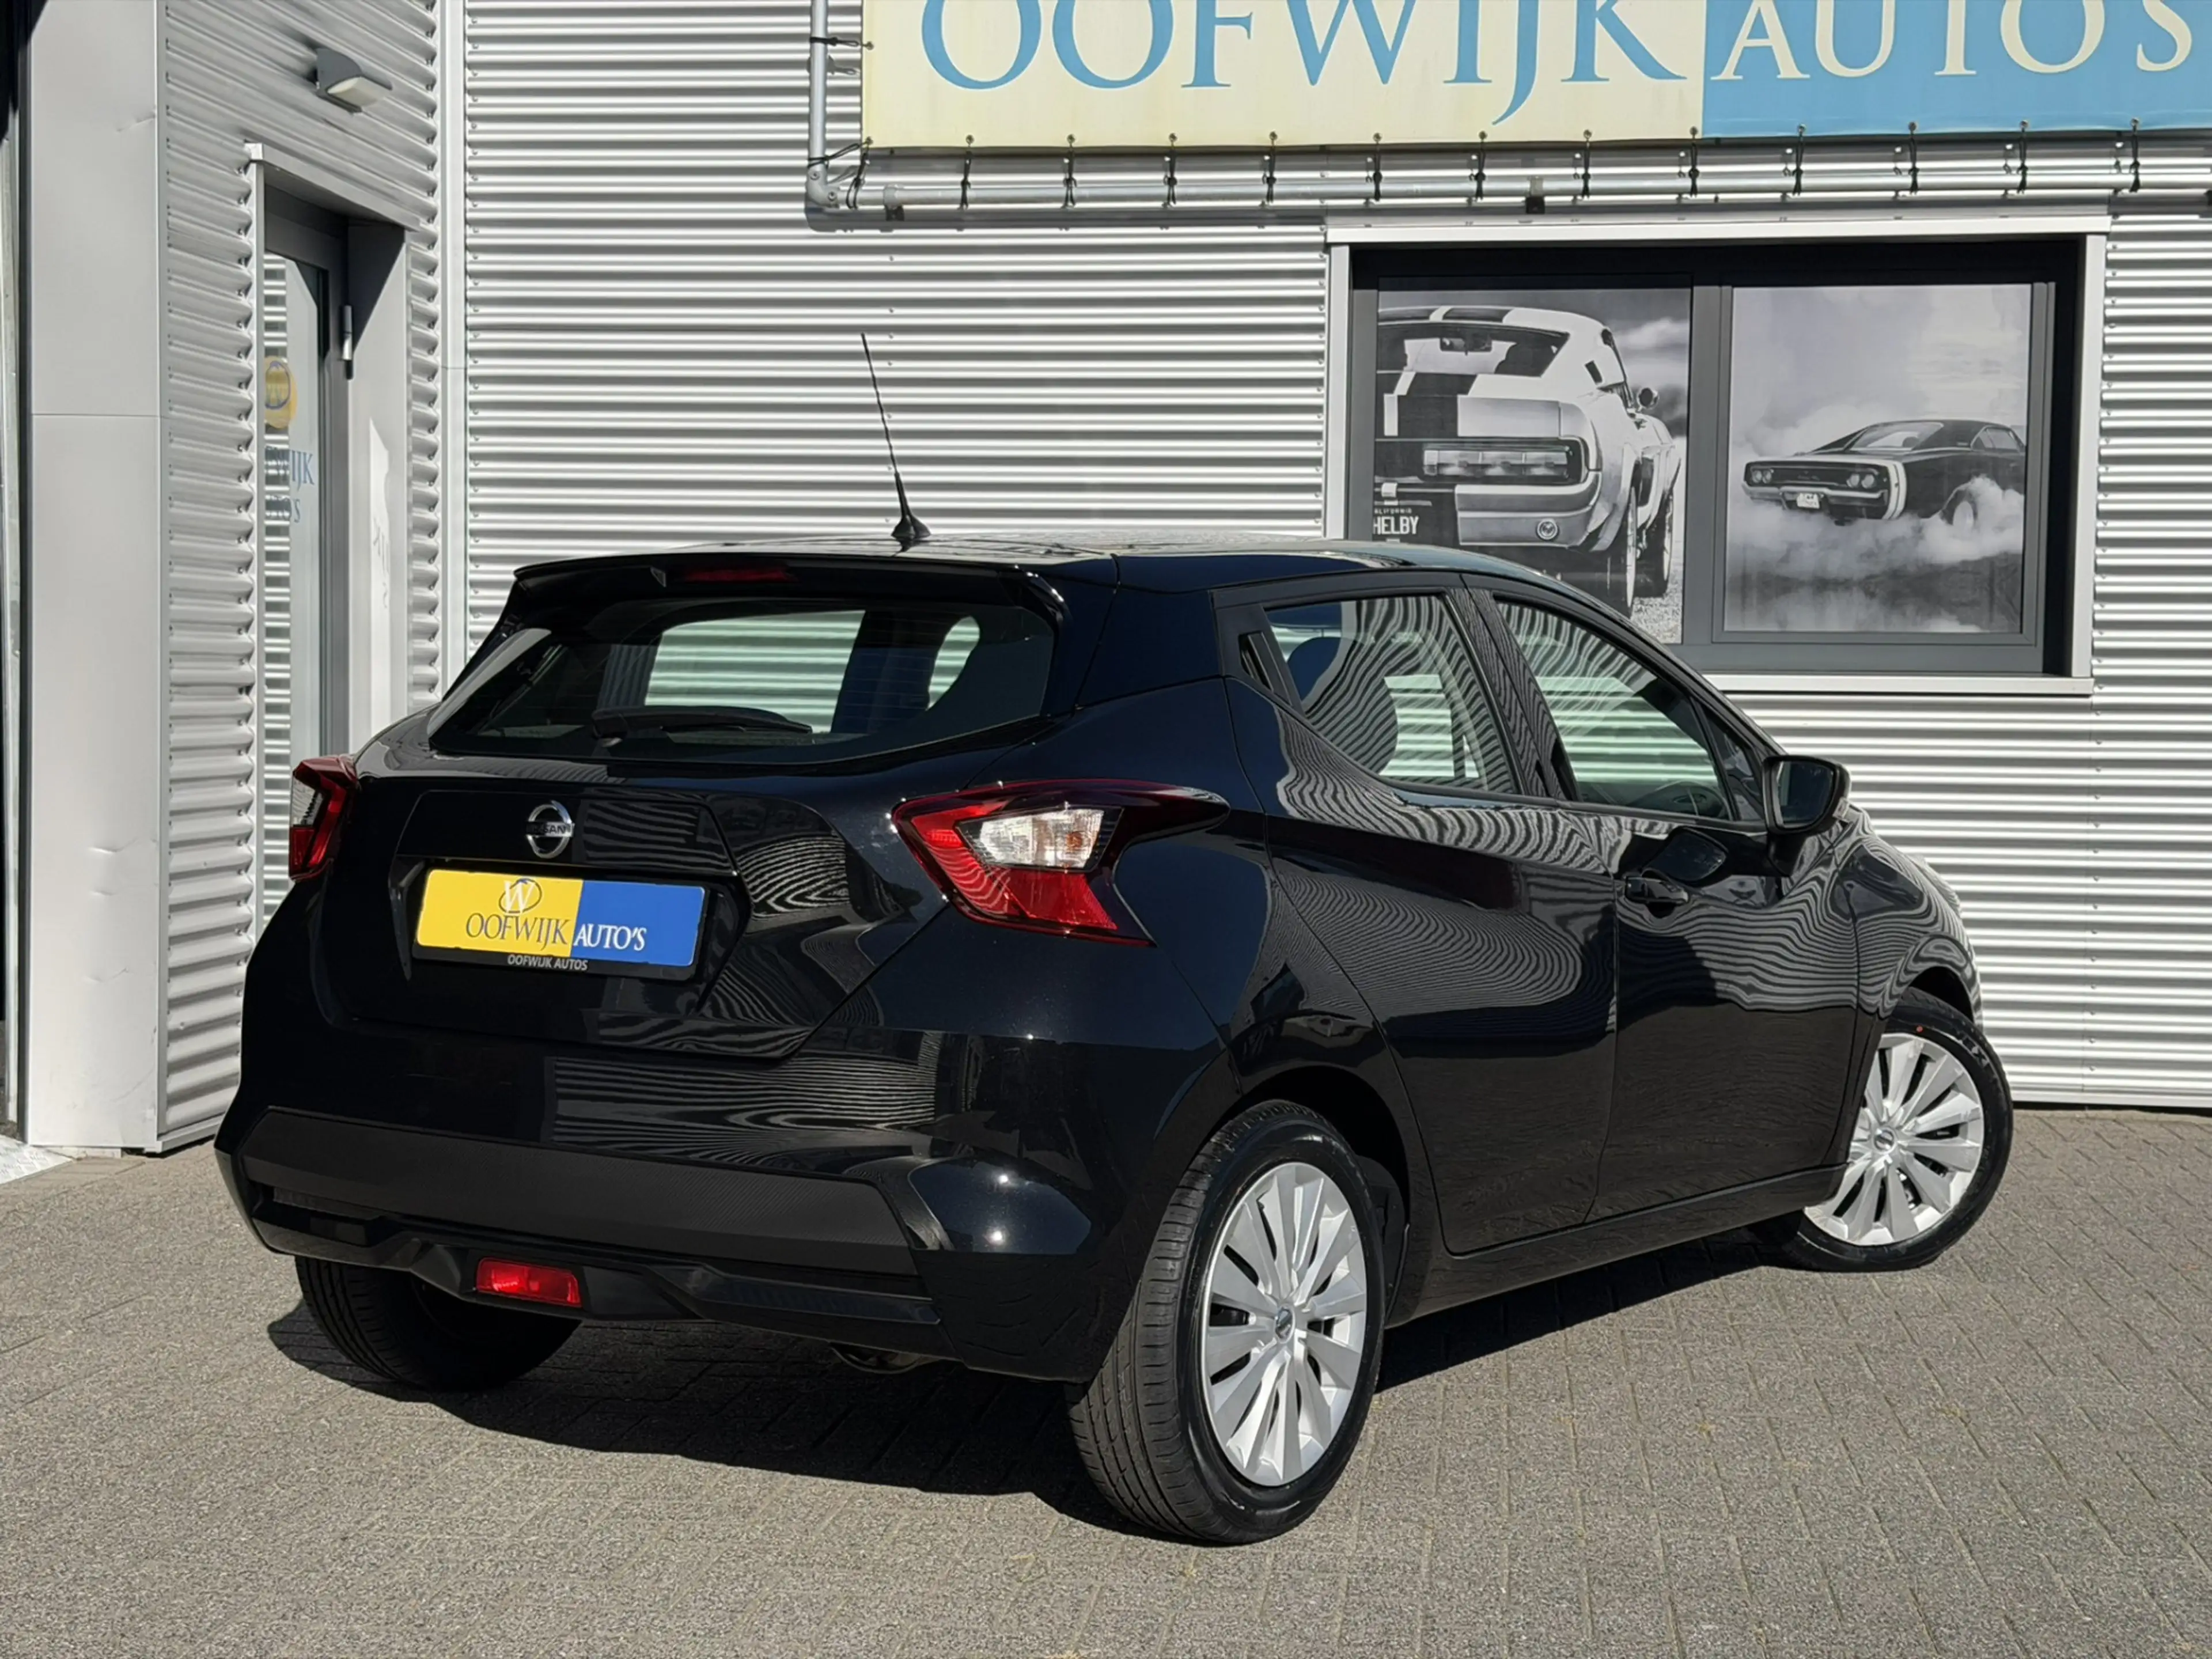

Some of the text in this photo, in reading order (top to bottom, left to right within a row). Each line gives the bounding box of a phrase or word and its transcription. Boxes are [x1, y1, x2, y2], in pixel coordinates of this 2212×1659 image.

[921, 0, 1688, 125] OOFWIJK
[466, 912, 647, 952] OOFWIJK AUTO'S
[507, 954, 589, 971] OOFWIJK AUTOS
